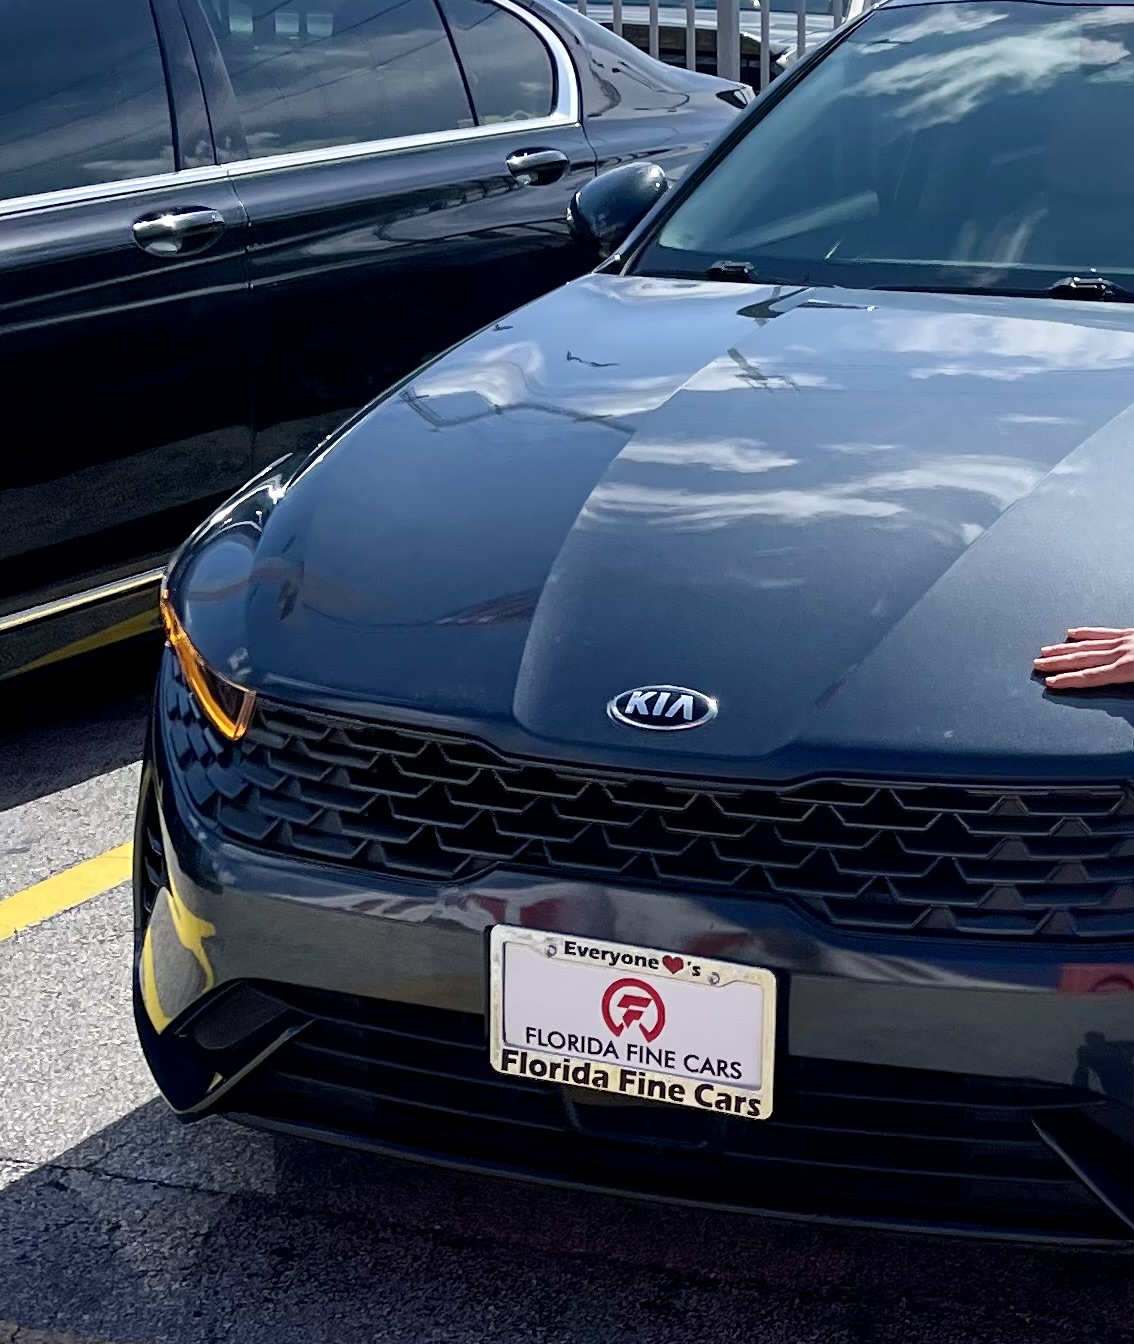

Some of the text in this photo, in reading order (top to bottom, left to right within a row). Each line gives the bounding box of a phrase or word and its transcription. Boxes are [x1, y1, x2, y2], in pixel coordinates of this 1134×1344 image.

[625, 691, 694, 720] KIA
[564, 941, 659, 969] Everyone
[526, 1026, 742, 1079] FLORIDA FINE CARS
[501, 1048, 761, 1116] Florida Fine Cars
